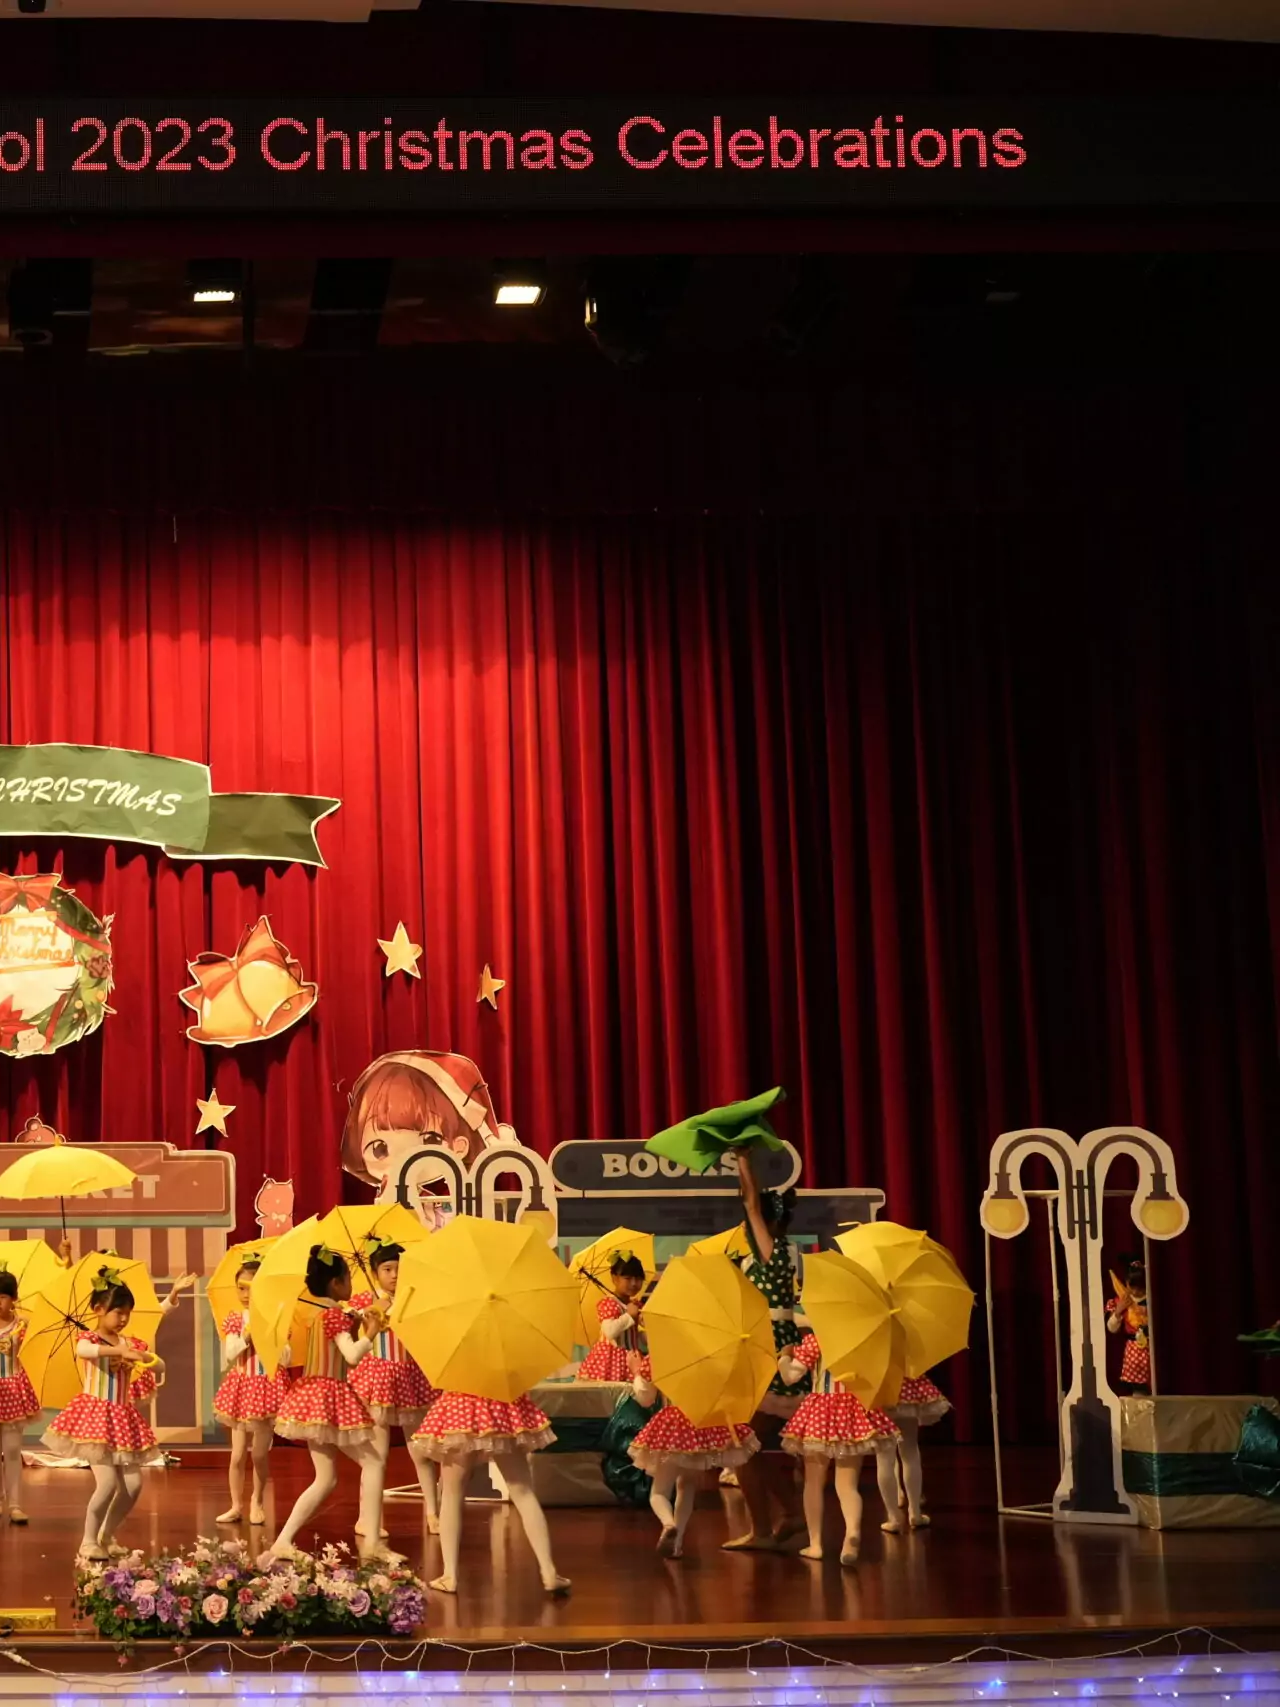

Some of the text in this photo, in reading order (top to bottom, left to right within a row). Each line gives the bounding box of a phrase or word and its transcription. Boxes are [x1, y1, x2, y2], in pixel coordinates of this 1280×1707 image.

[72, 118, 237, 171] 2023
[261, 118, 594, 171] Christmas
[618, 116, 1027, 170] Celebrations
